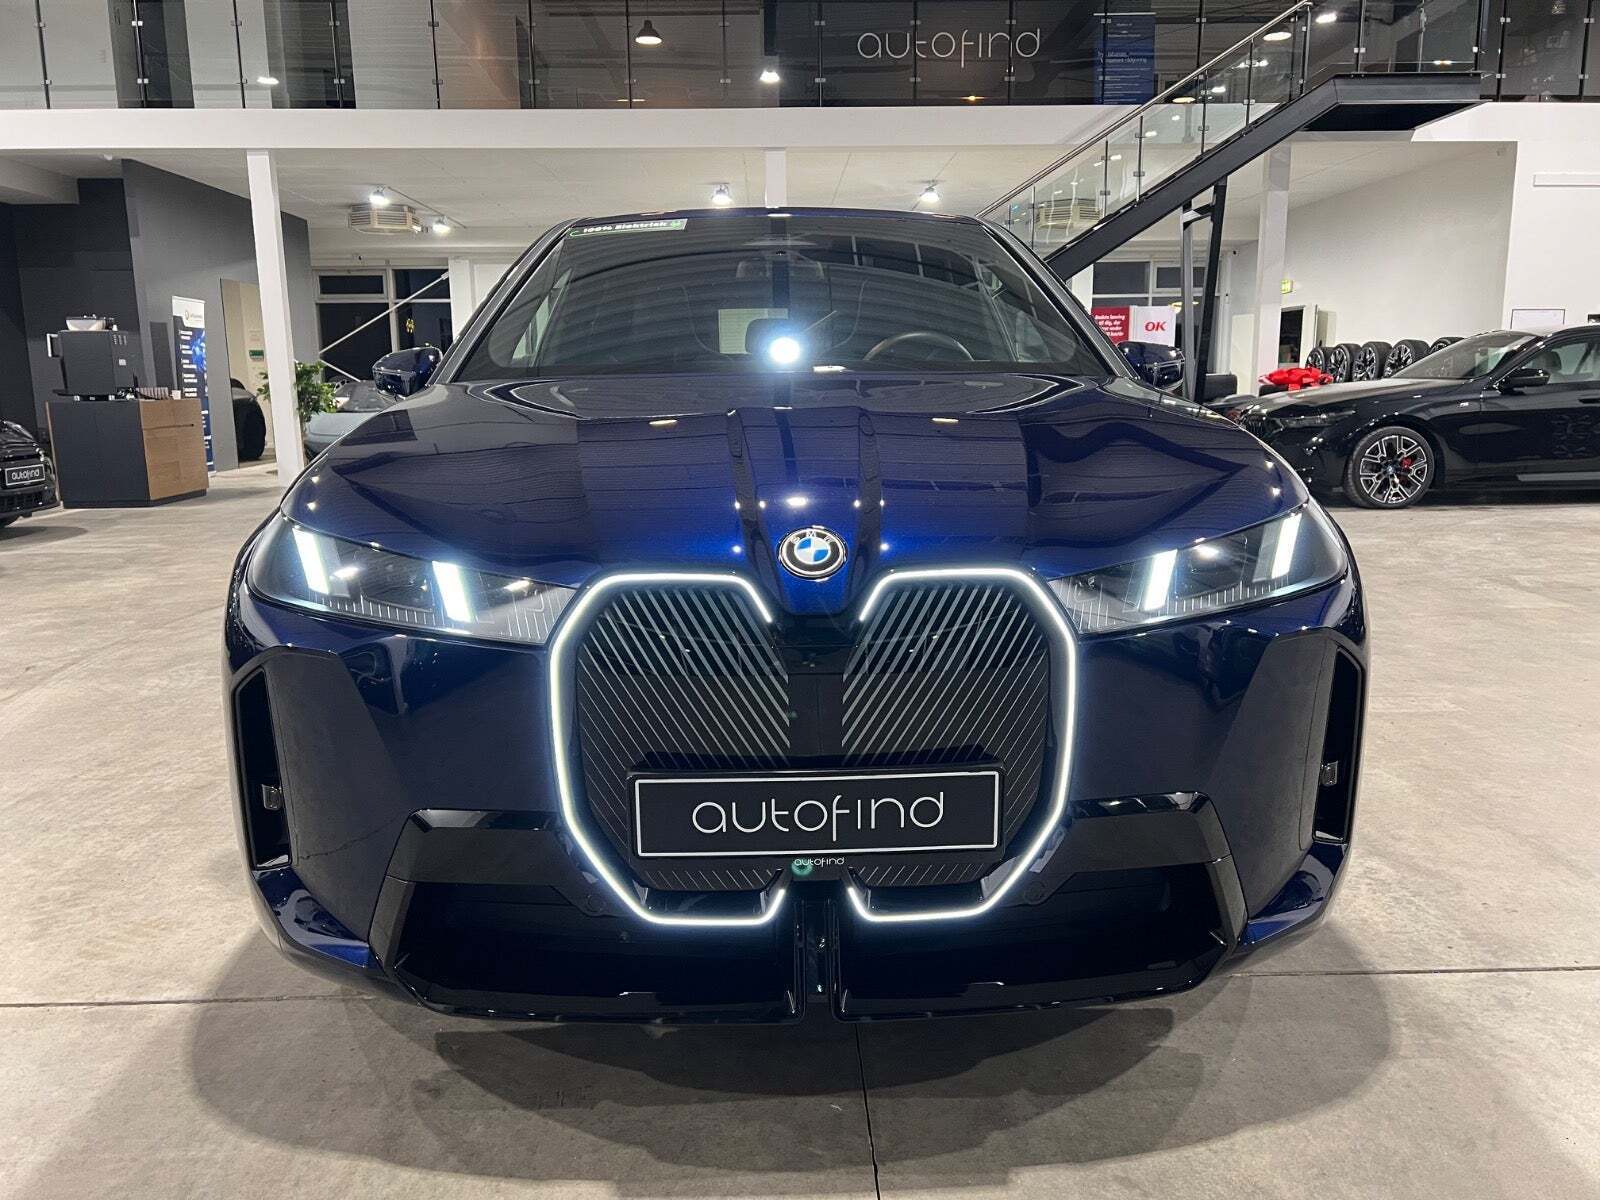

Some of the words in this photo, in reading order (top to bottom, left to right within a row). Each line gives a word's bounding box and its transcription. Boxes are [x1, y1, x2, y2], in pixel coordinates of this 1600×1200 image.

[857, 28, 1041, 68] autofind
[1144, 321, 1168, 332] OK
[11, 469, 40, 480] autofind
[692, 791, 944, 842] autofind
[794, 857, 845, 868] autofind
